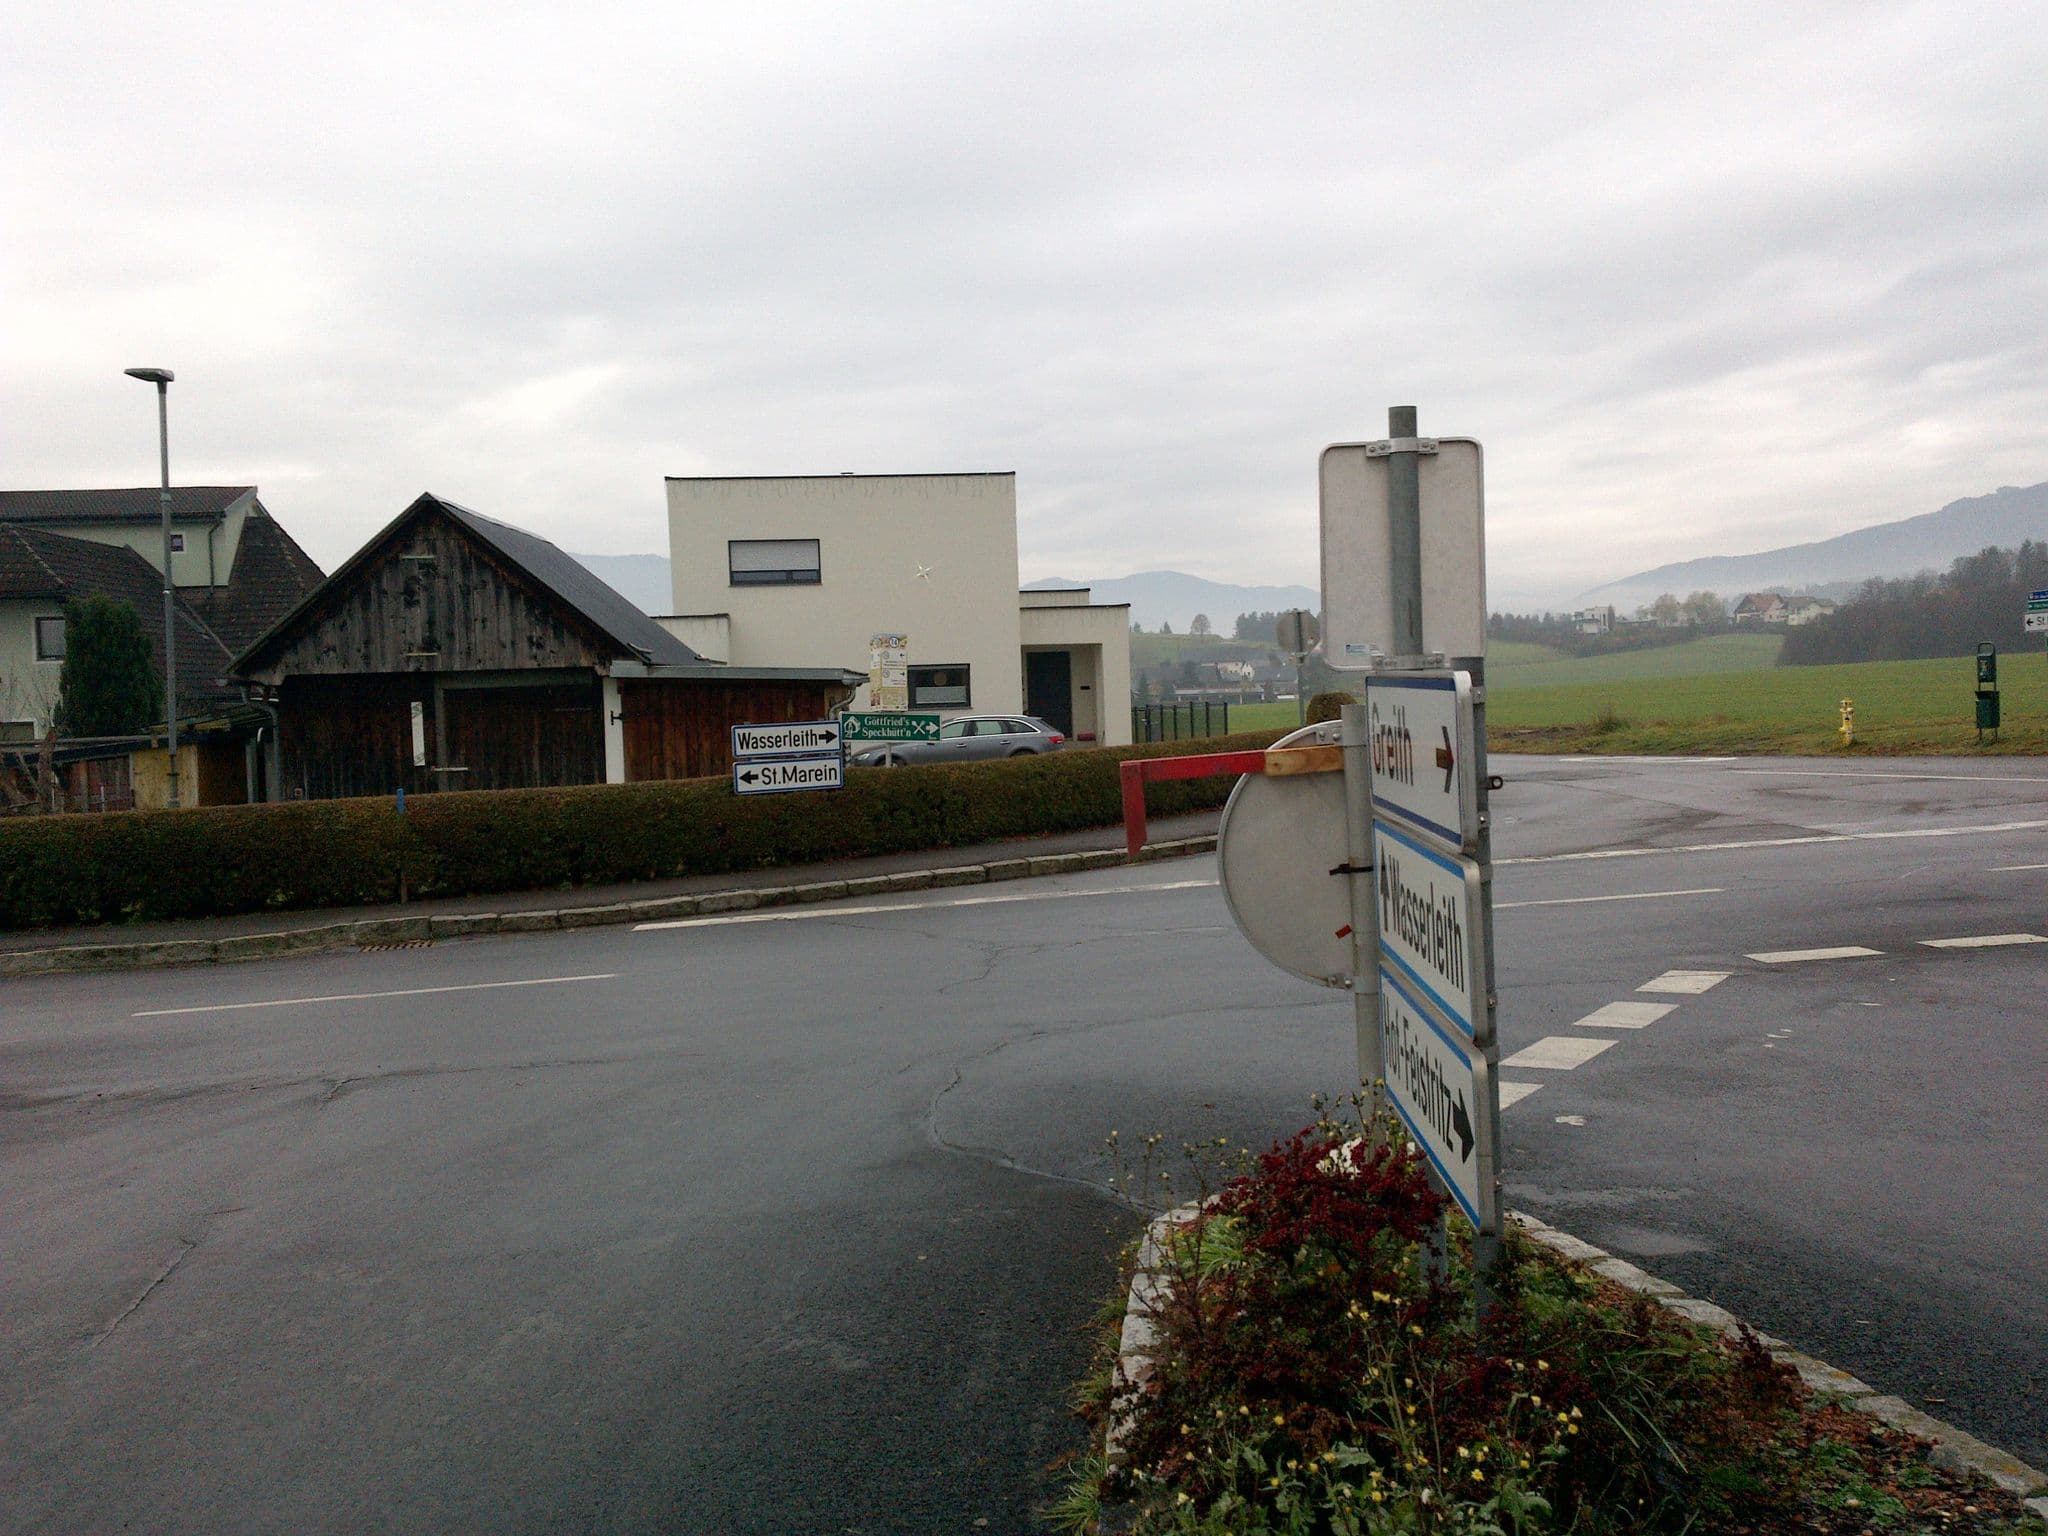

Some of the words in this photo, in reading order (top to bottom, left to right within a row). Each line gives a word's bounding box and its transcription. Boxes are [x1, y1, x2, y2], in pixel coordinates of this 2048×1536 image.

[737, 729, 819, 751] Wasserleith
[1372, 701, 1414, 787] Greith
[1388, 854, 1465, 993] Wasserleith
[1383, 994, 1454, 1153] Hof-Feistritz
